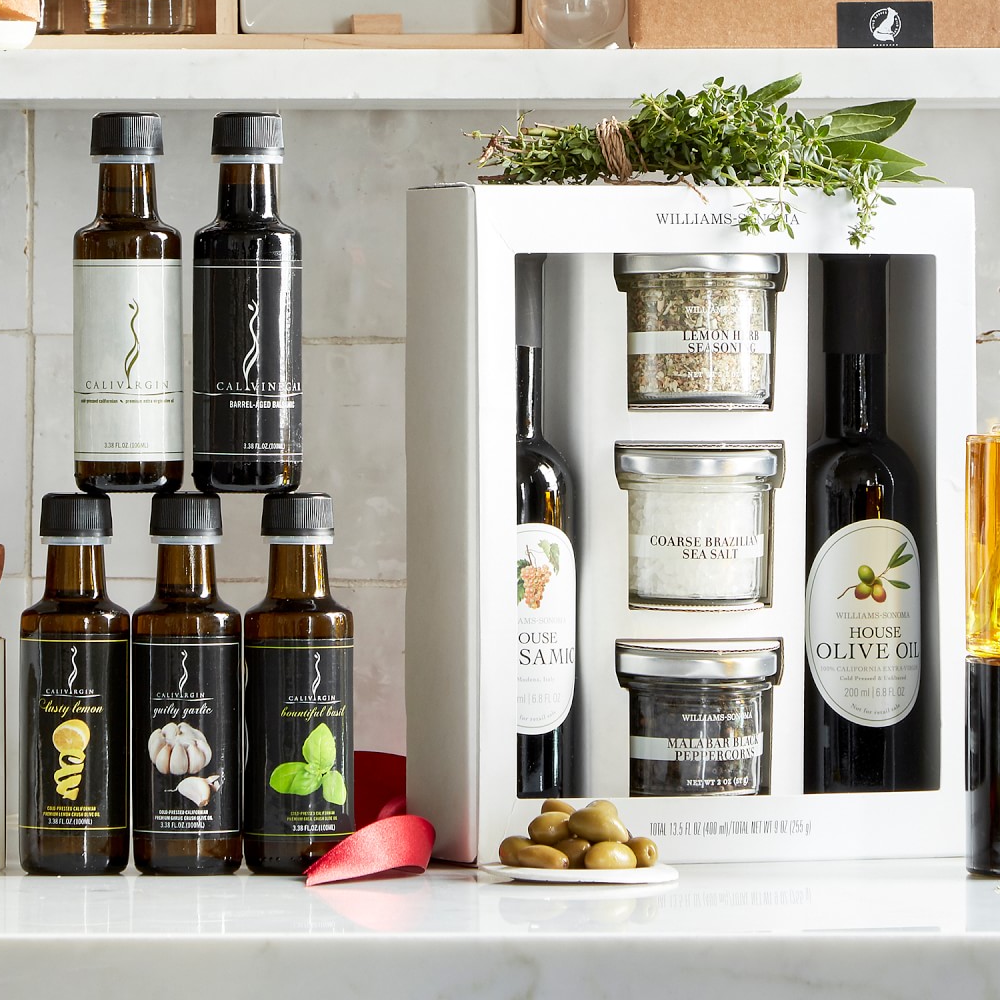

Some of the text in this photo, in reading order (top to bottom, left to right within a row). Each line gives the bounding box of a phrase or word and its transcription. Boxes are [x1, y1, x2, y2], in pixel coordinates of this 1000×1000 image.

[656, 213, 800, 226] WILLIAMS-SNOA
[683, 331, 760, 341] LEMON HRB
[687, 342, 756, 353] SEASONIG
[85, 380, 170, 390] CALIVIRGIN
[229, 400, 272, 409] BARREL-AGED
[650, 535, 758, 547] COARSE BRAZILIAN
[682, 549, 738, 560] SEA SALT
[836, 611, 911, 620] WILLIAMS-SONOMA
[518, 631, 557, 645] OUSE
[849, 626, 902, 639] HOUSE
[816, 641, 920, 660] OLIVE OIL
[518, 648, 575, 666] SAMIC
[156, 691, 205, 699] CALIVIRGIN
[288, 694, 336, 702] CALIVIRGIN
[844, 686, 905, 698] 200 ml 6.8 FL OZ
[39, 699, 104, 719] lusty lemon
[151, 702, 213, 719] guilty garlic
[280, 704, 345, 722] bountiful basil
[682, 711, 754, 722] WILLIAMS-SONOMA
[667, 734, 760, 749] MALABAR BLACK
[675, 747, 756, 761] PEPPERCORNS
[686, 779, 703, 787] NET
[722, 778, 732, 786] OZ
[650, 822, 667, 836] TOTAL
[669, 822, 684, 836] 13.5
[684, 822, 692, 836] FL
[693, 822, 701, 836] OZ
[702, 822, 718, 837] (400
[750, 820, 763, 834] NET
[762, 820, 773, 834] WT
[774, 820, 779, 834] 9
[779, 820, 788, 834] OZ
[789, 820, 804, 835] (255
[805, 820, 812, 835] g)
